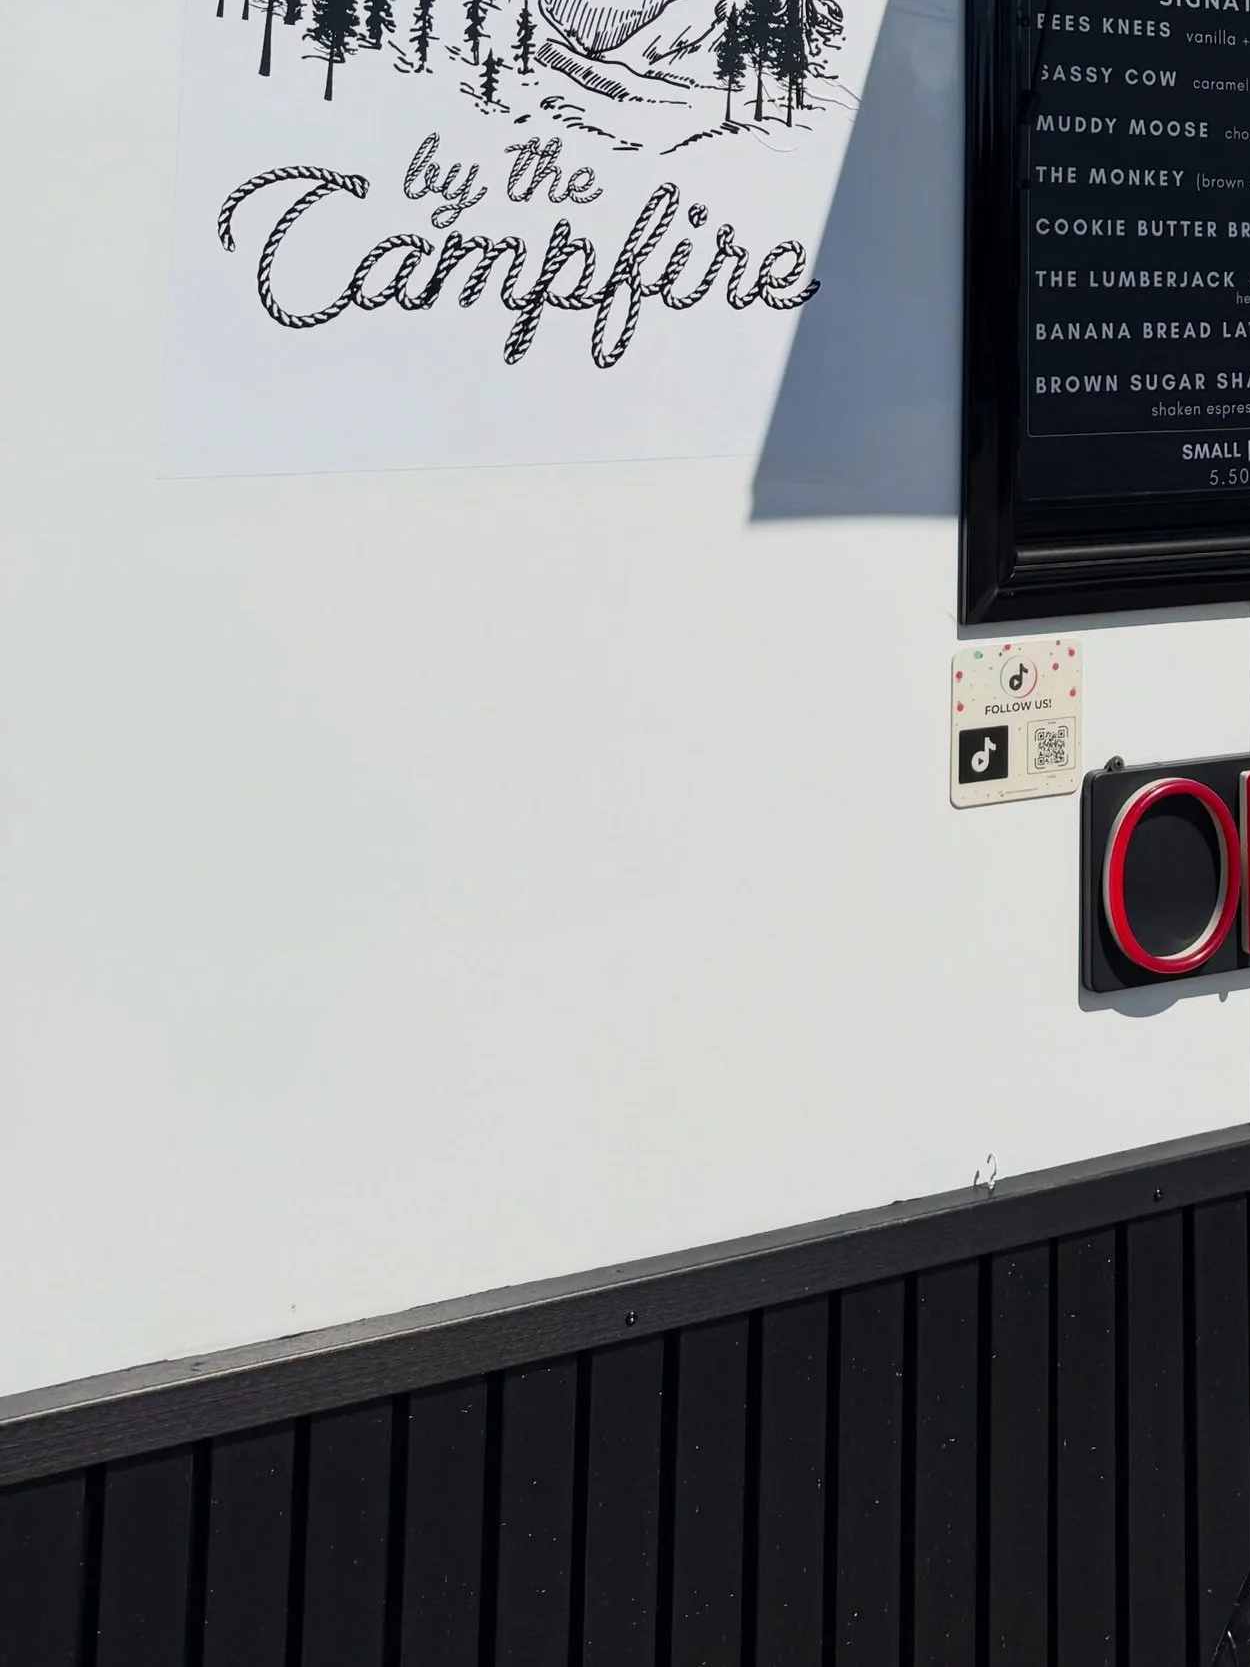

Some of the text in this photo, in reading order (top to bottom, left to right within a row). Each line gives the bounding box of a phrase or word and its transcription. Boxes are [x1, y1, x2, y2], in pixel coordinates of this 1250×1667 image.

[1103, 17, 1170, 37] KNEES
[1186, 29, 1236, 45] vanilla
[1125, 69, 1176, 87] COW
[1193, 78, 1248, 91] caramel
[1036, 115, 1117, 134] MUDDY
[1129, 119, 1208, 138] MOOSE
[404, 132, 604, 227] by the
[1036, 166, 1184, 186] THE MONKEY
[1036, 218, 1125, 236] COOKIE
[1138, 220, 1217, 237] BUTTER
[217, 165, 821, 369] Campfire
[1035, 271, 1234, 287] THE LUMBERJACK
[1036, 322, 1131, 340] BANANA
[1143, 322, 1211, 339] BREAD
[1036, 375, 1117, 393] BROWN
[1130, 373, 1205, 391] SUGAR
[1182, 442, 1241, 460] SMALL
[1210, 468, 1249, 485] 5.50
[984, 698, 1052, 715] FOLLOW US!
